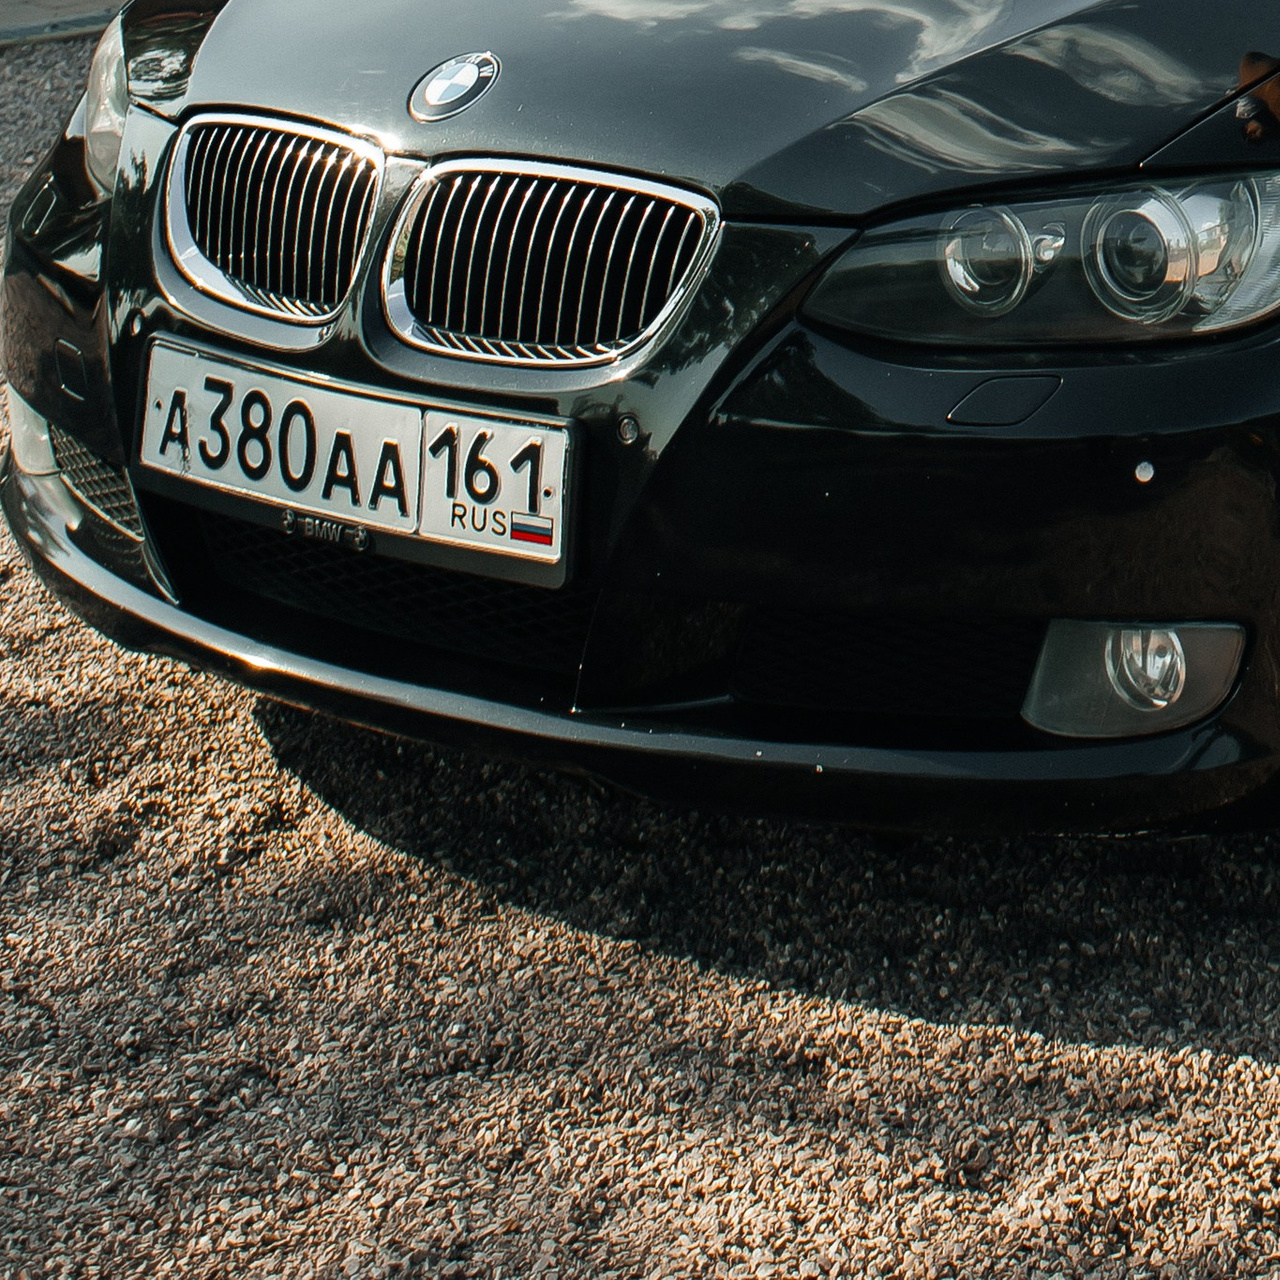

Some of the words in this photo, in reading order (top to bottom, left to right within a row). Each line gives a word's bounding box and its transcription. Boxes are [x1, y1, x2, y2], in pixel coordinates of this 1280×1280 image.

[159, 376, 408, 516] A380AA
[428, 424, 542, 514] 161
[305, 517, 343, 542] BMW
[451, 501, 507, 536] RUS
